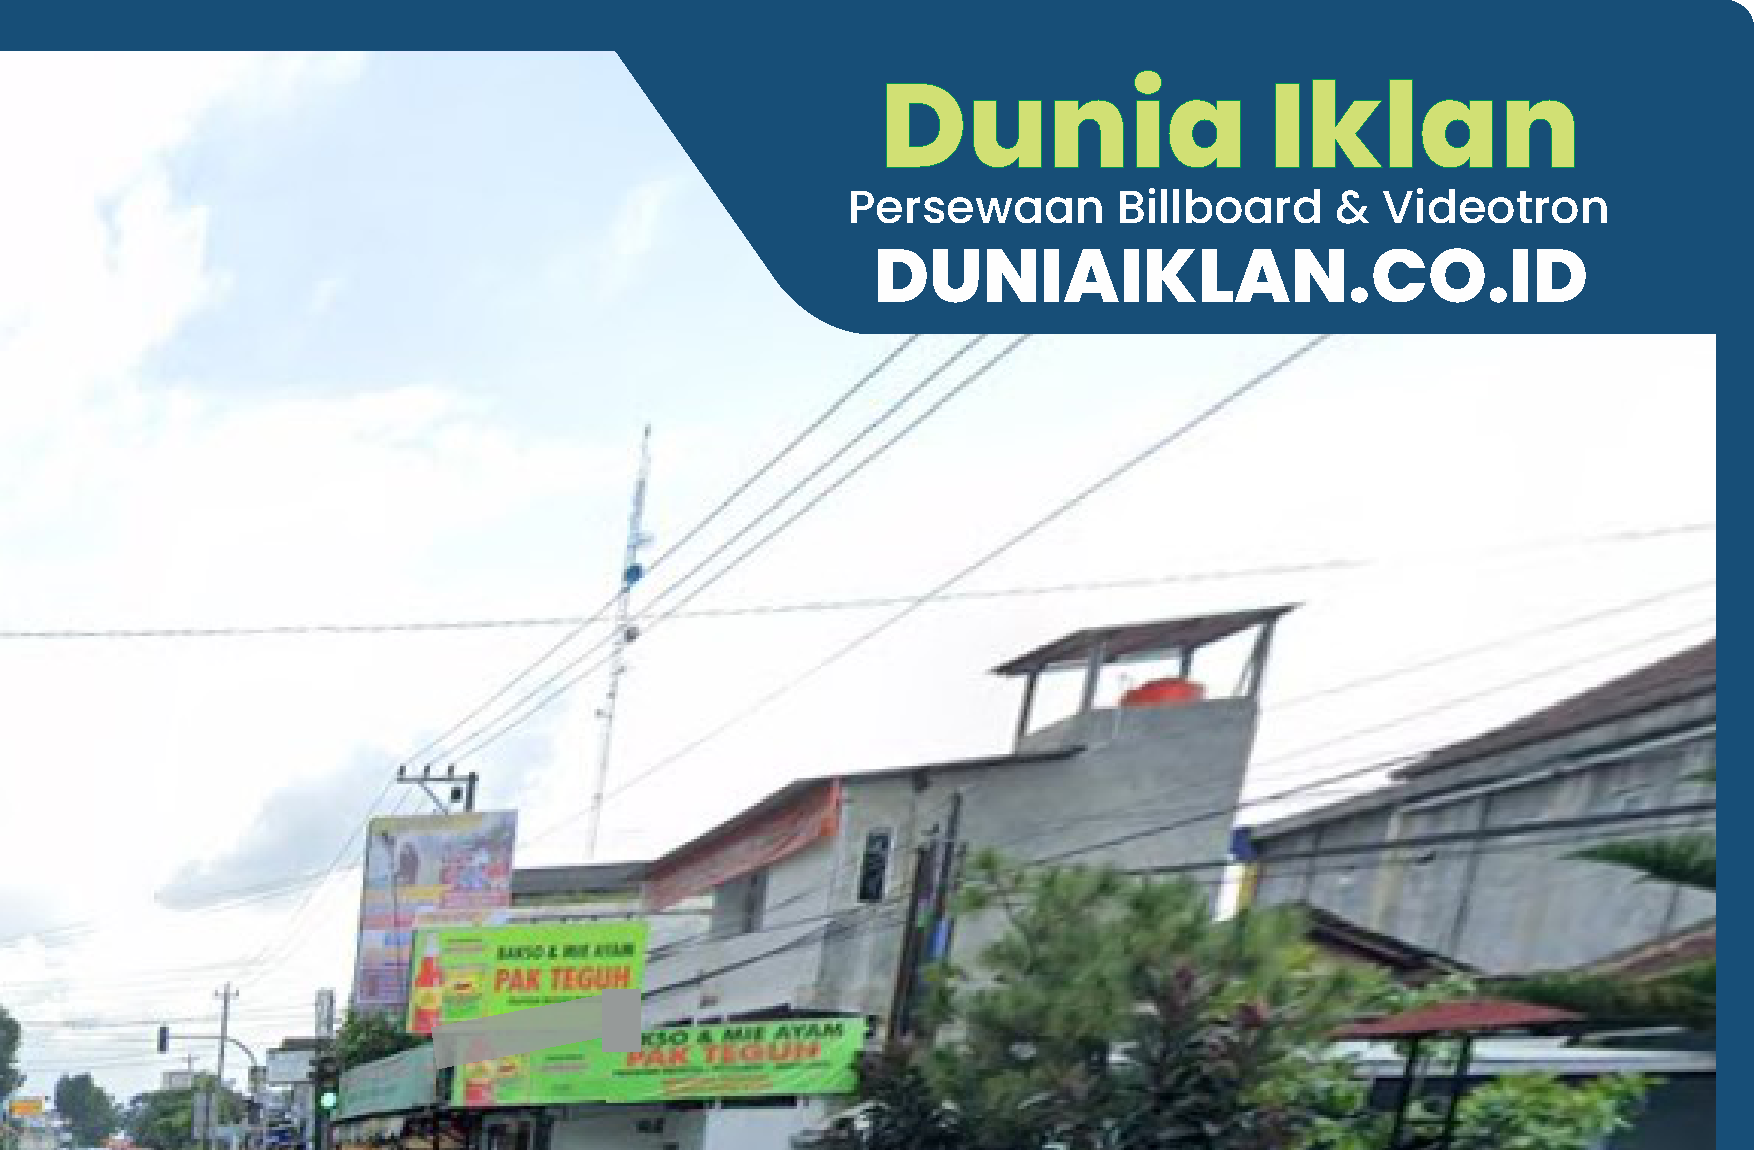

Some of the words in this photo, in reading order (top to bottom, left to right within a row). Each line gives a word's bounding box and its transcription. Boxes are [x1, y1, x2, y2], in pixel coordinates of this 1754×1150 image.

[497, 943, 545, 960] BAKSO
[494, 968, 540, 993] PAK
[550, 966, 631, 990] TEGUH
[723, 1026, 765, 1040] MIE
[773, 1023, 844, 1039] AYAM
[626, 1047, 689, 1067] PAK
[703, 1042, 821, 1064] TEGUH
